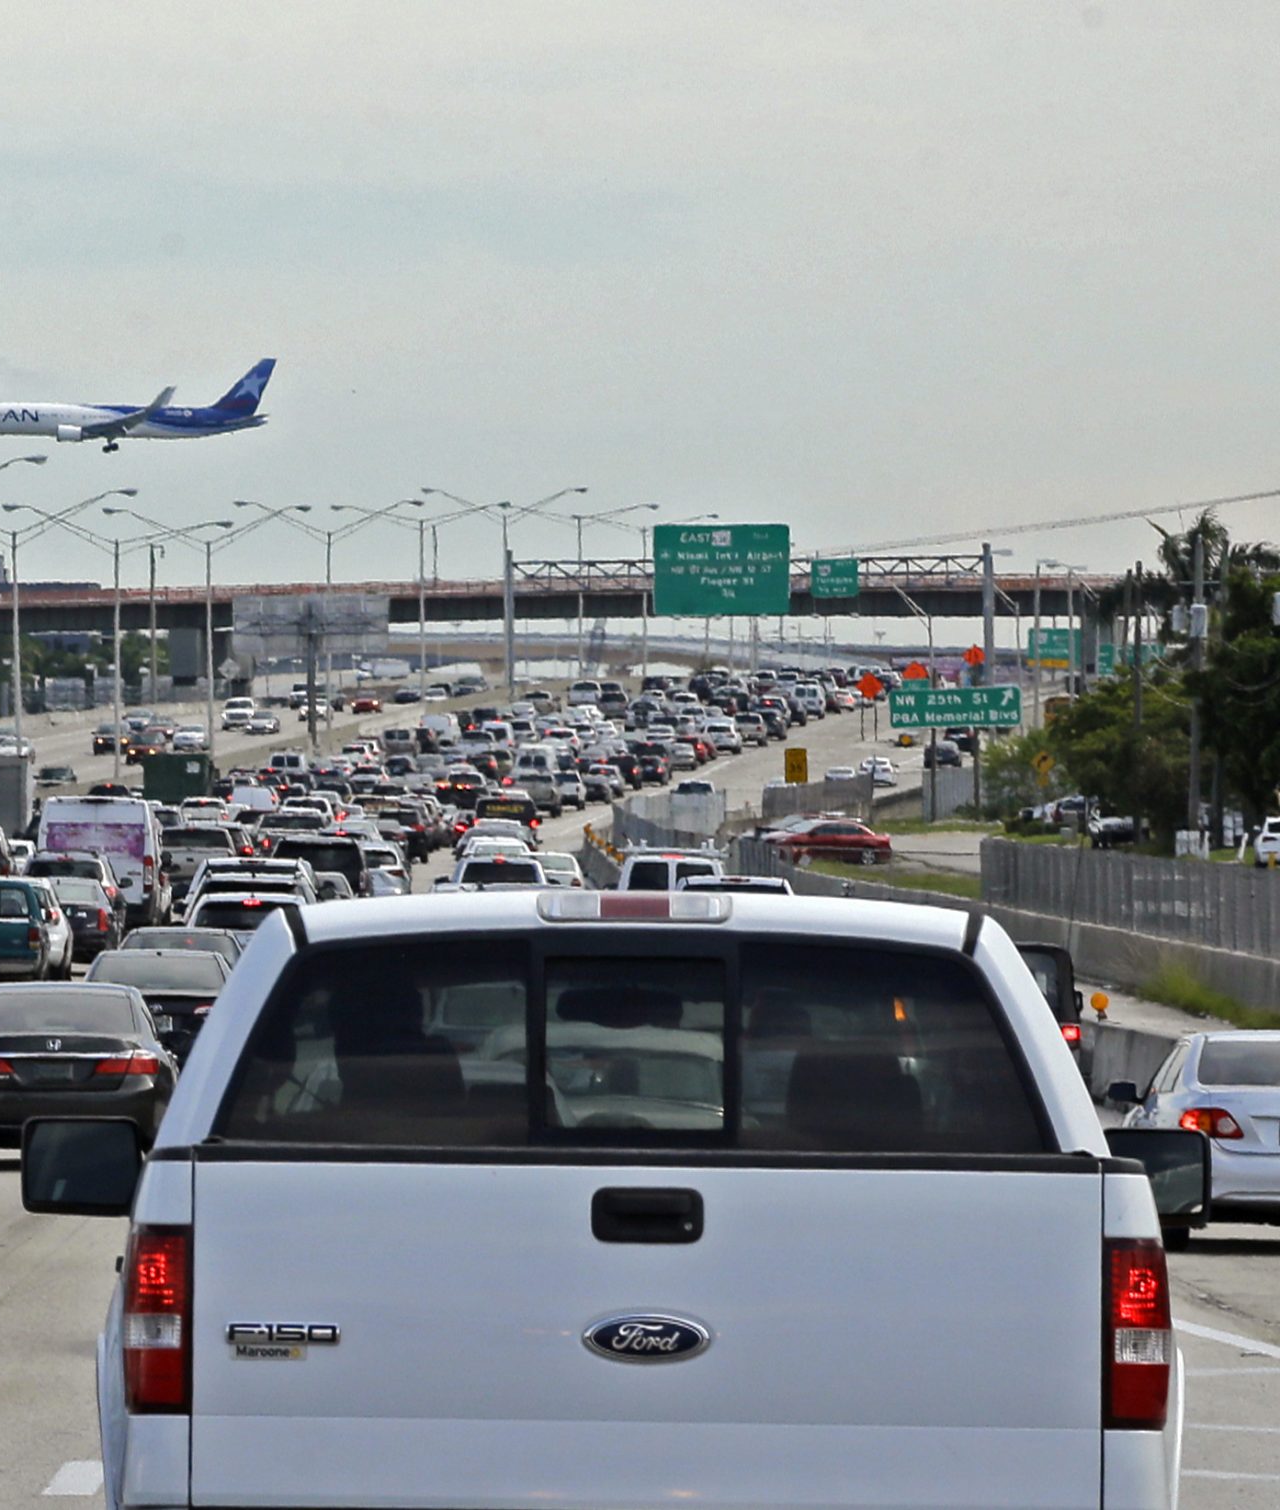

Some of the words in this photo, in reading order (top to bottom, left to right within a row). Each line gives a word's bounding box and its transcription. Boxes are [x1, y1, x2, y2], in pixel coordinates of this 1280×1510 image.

[680, 532, 710, 543] EAST
[895, 695, 915, 706] NW
[927, 694, 961, 705] 25th
[972, 692, 988, 704] St
[925, 710, 984, 722] Memorial
[989, 710, 1018, 721] Blvd
[612, 1323, 680, 1351] Ford
[236, 1346, 291, 1357] Maroone
